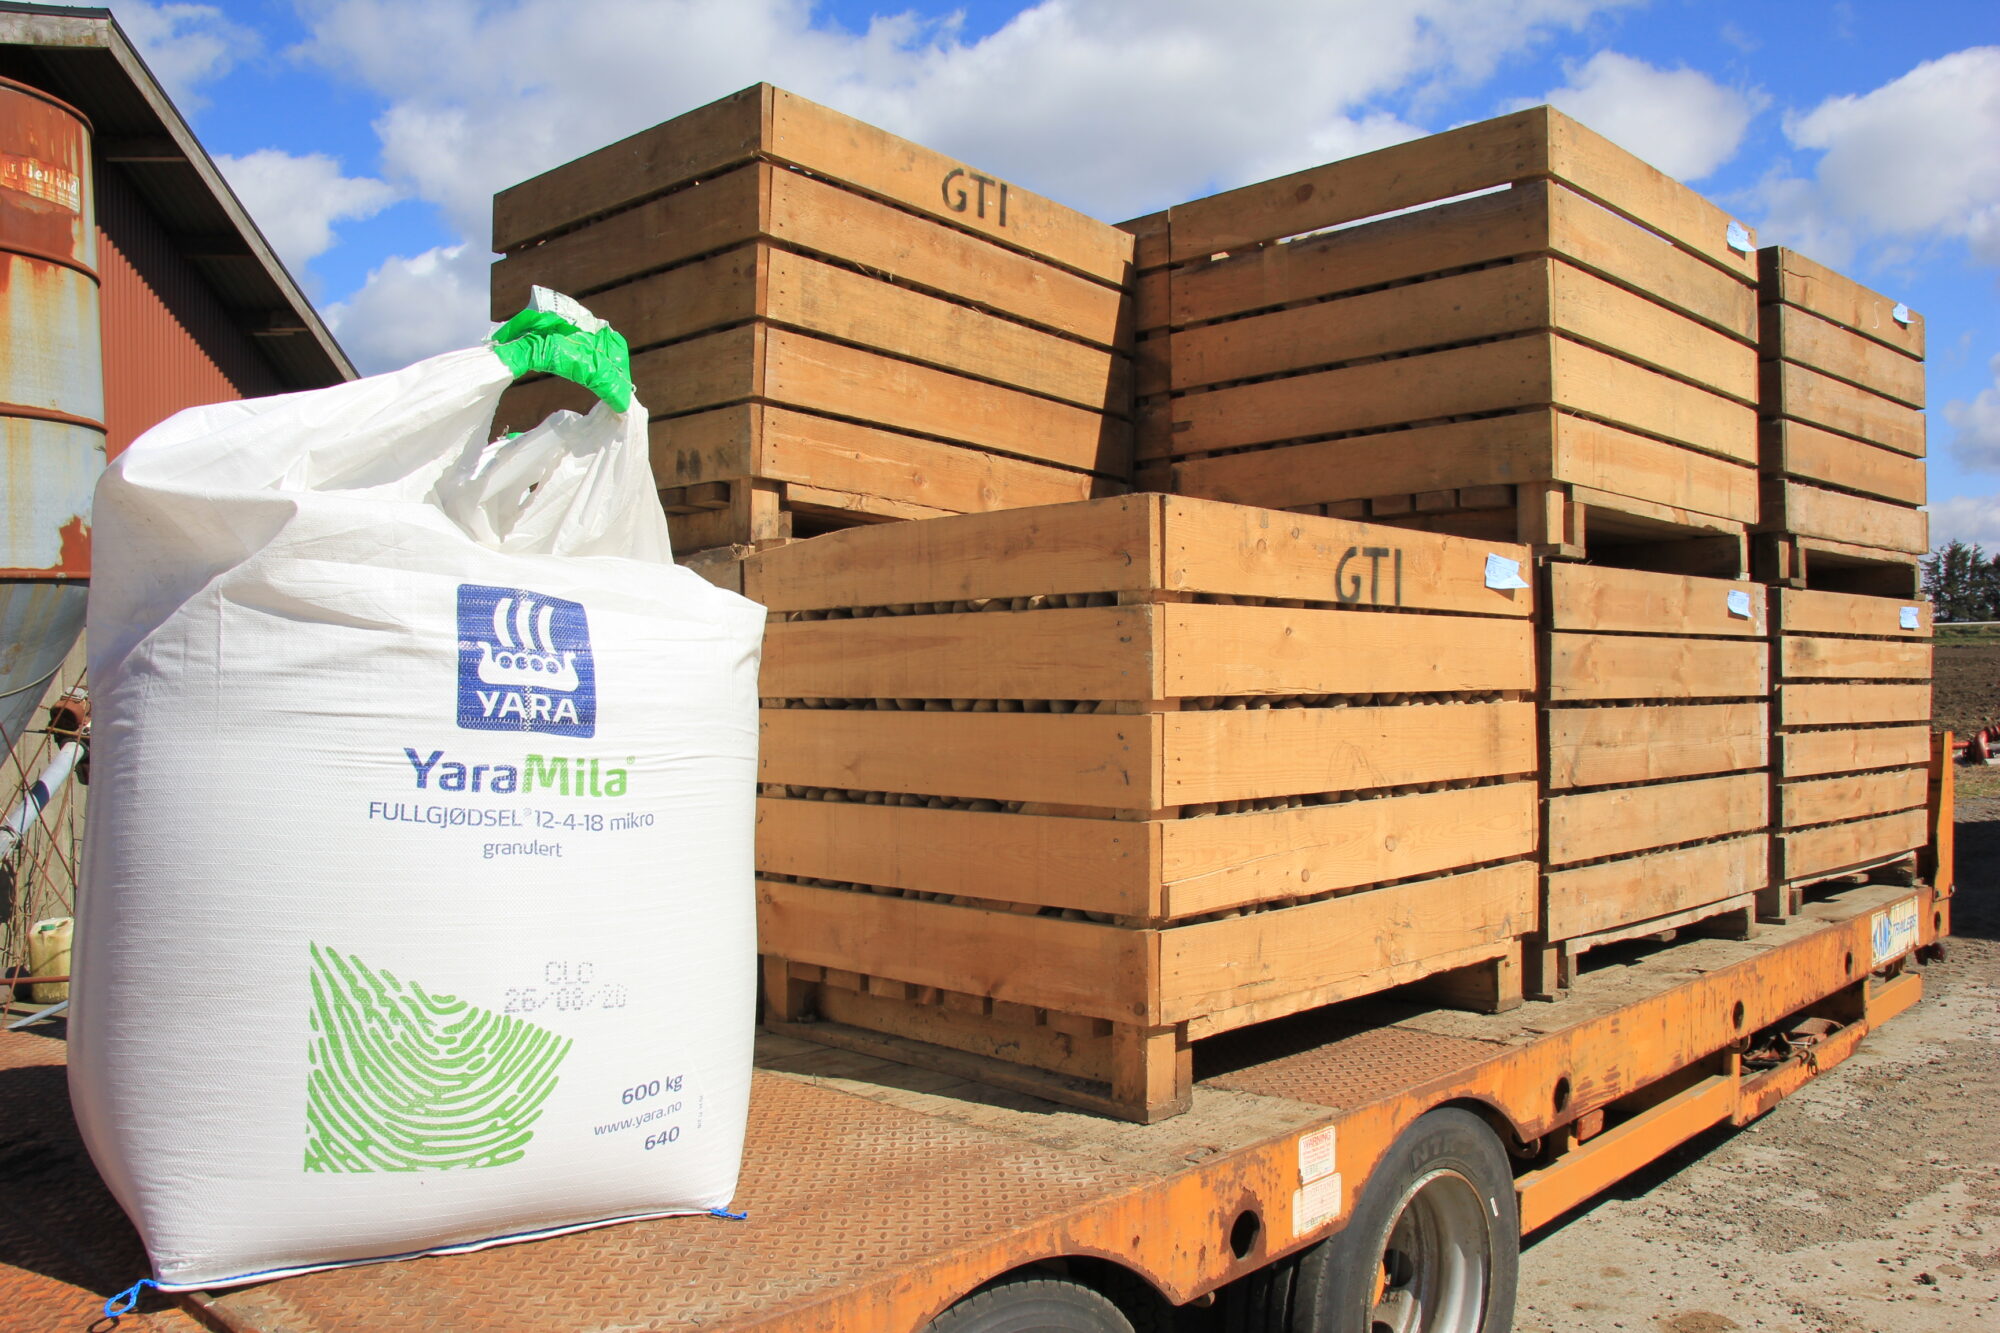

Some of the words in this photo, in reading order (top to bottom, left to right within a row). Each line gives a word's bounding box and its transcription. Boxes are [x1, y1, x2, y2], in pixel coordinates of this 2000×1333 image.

[941, 167, 1008, 228] GTI
[1335, 546, 1402, 606] GTI
[475, 690, 579, 725] YARA
[536, 810, 604, 832] 12-4-18
[609, 811, 655, 832] mikro
[482, 839, 563, 859] granulert
[621, 1079, 661, 1105] 600
[665, 1074, 684, 1092] kg
[593, 1100, 683, 1136] www.yara.no
[644, 1125, 681, 1151] 640
